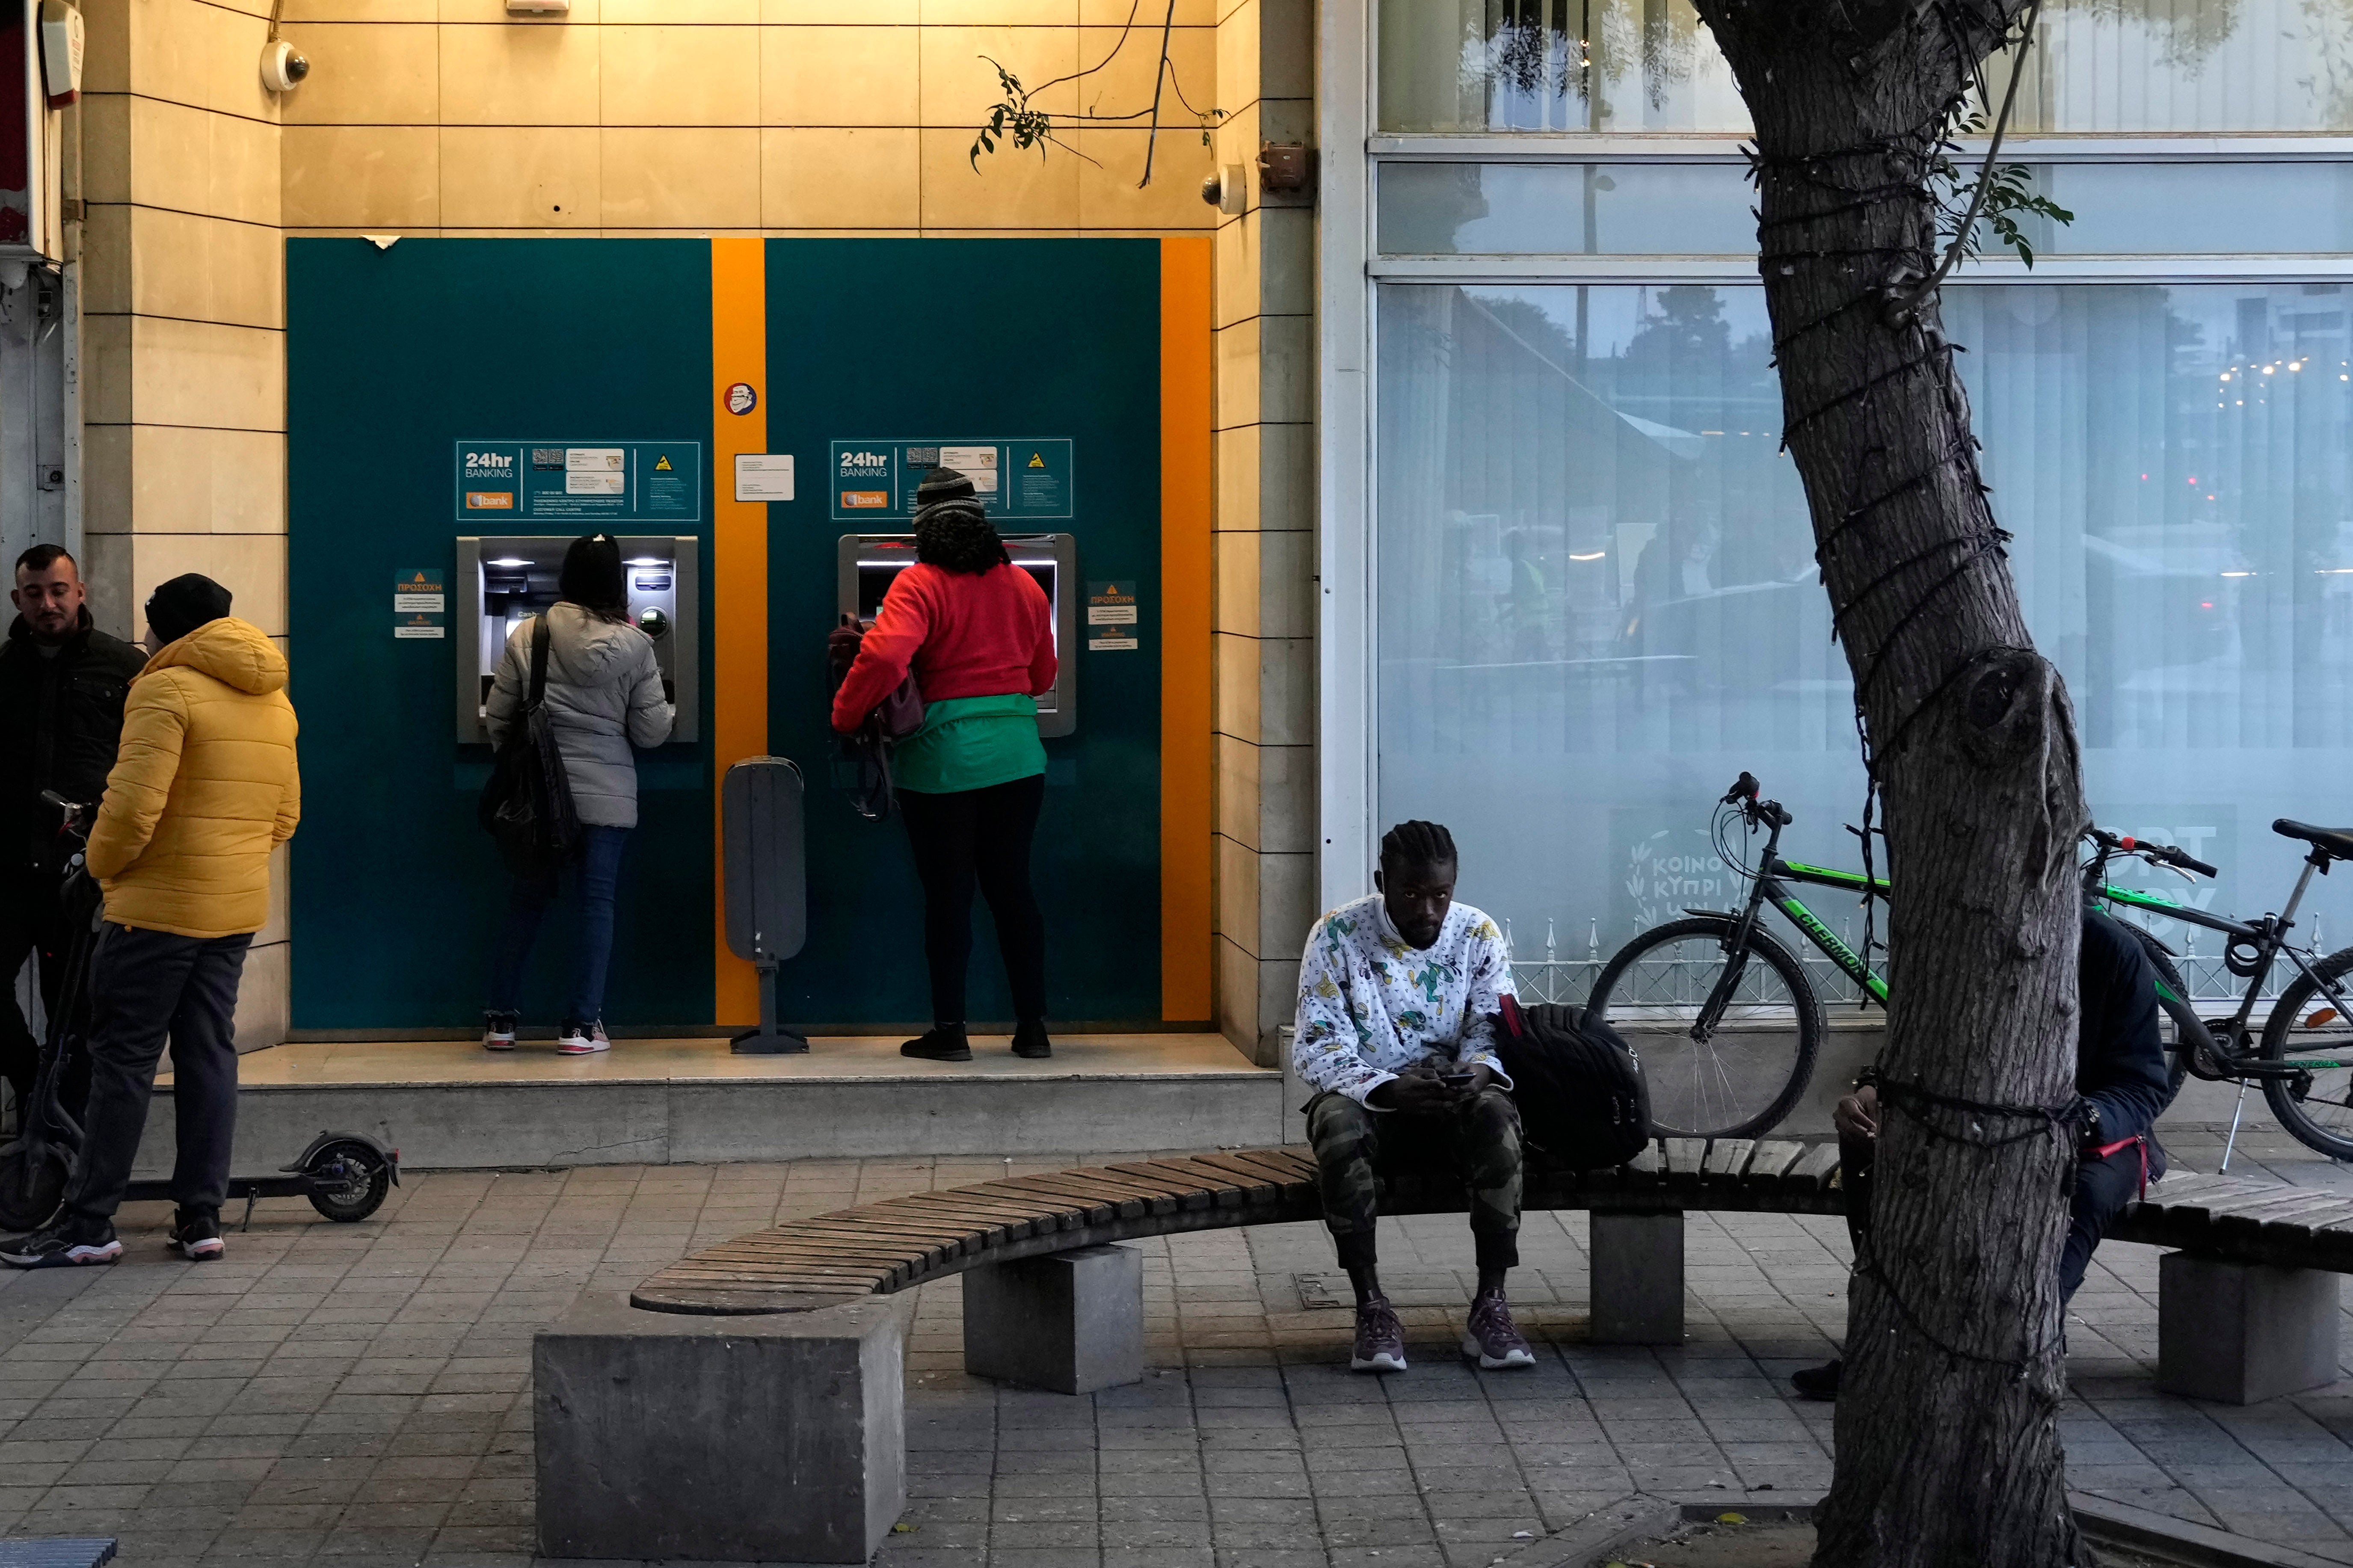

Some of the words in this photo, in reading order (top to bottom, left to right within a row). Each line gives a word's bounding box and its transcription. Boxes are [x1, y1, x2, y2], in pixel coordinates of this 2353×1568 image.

[466, 453, 513, 467] 24hr
[841, 452, 887, 467] 24hr
[465, 469, 513, 478] BANKING
[840, 468, 887, 477] BANKING
[398, 583, 442, 592] ΠΡΟΣΟΧΗ
[1799, 913, 1878, 981] CLERMOT
